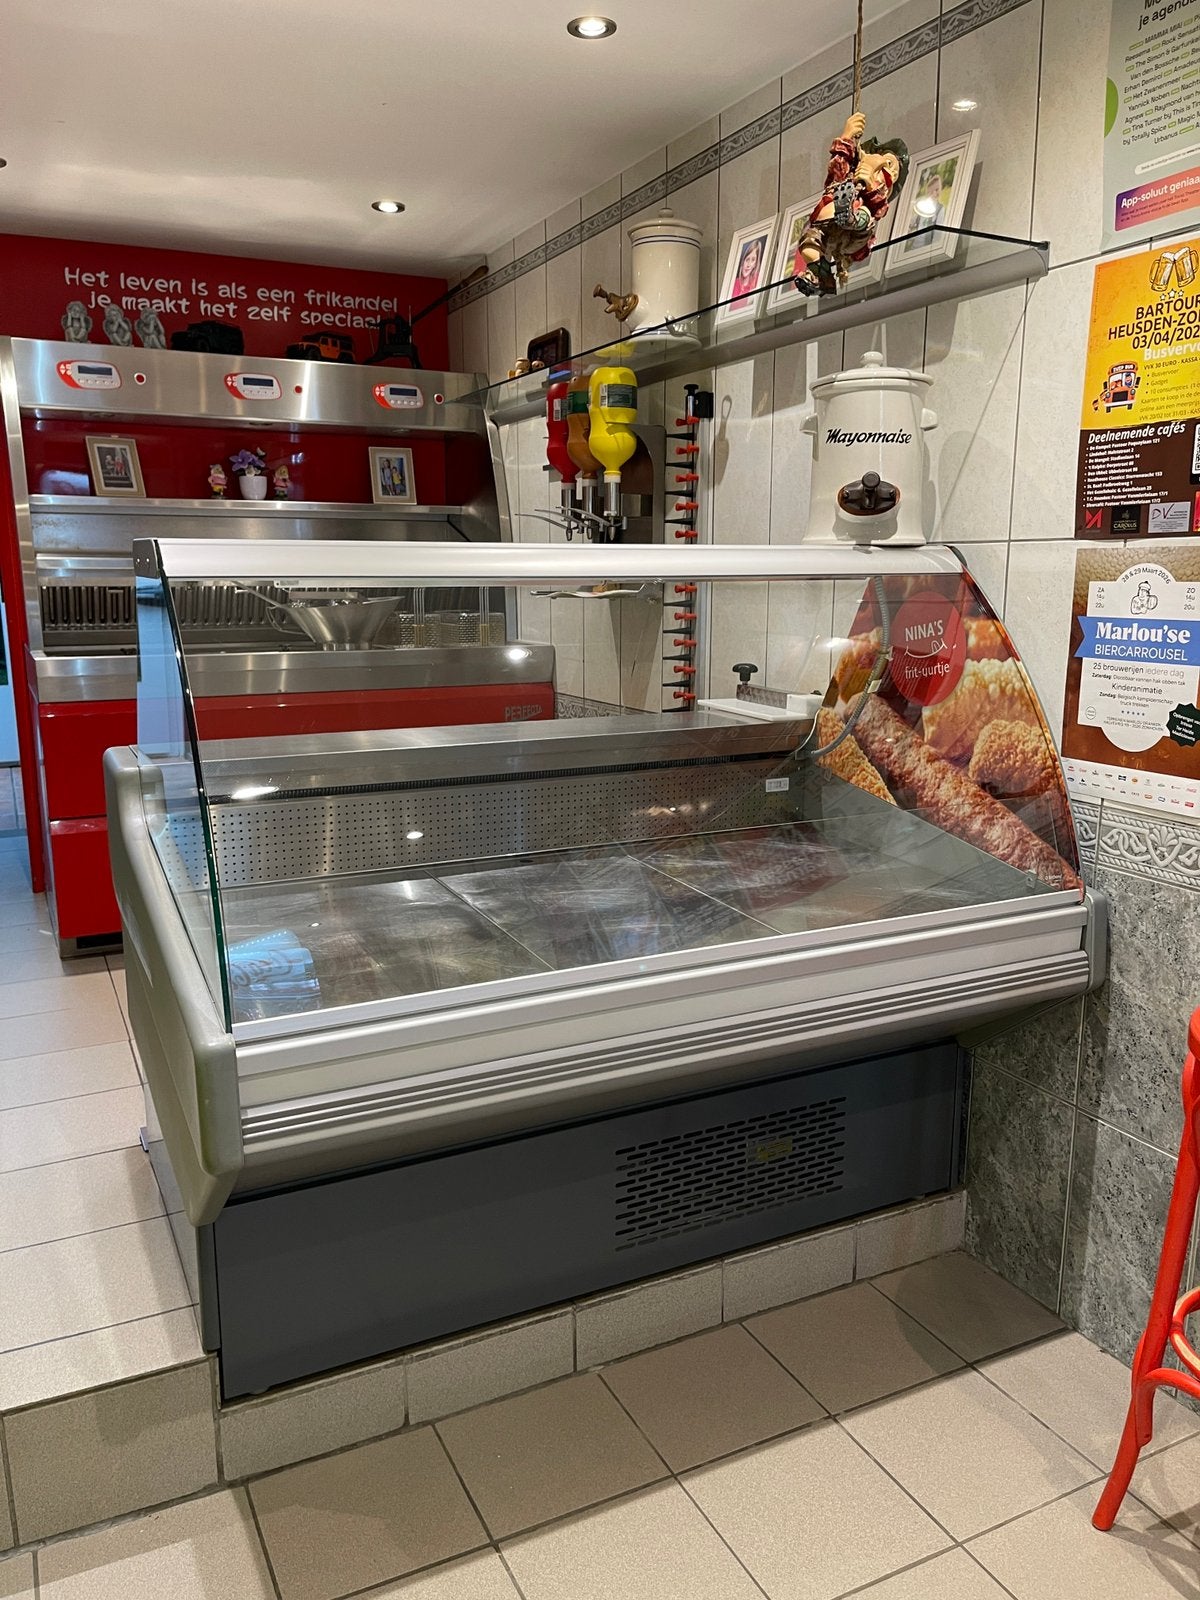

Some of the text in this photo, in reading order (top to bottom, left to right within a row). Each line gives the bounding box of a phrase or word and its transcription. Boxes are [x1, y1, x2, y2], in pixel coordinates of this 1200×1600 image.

[1137, 15, 1150, 31] je
[1162, 37, 1176, 47] Rock
[1135, 60, 1146, 68] The
[1147, 52, 1166, 63] Simon
[1155, 96, 1183, 112] Raymond
[1163, 112, 1172, 120] by
[1173, 107, 1185, 115] This
[1123, 138, 1131, 146] by
[1151, 125, 1167, 135] Spice
[1154, 131, 1178, 144] Urbanus
[1121, 184, 1168, 209] App-soluut
[65, 266, 109, 288] Het
[119, 272, 182, 293] leven
[218, 283, 248, 300] als
[257, 287, 296, 304] een
[303, 289, 398, 313] frikandel
[88, 291, 112, 309] je
[121, 296, 191, 315] maakt
[200, 299, 239, 319] het
[246, 305, 293, 322] zelf
[825, 427, 912, 447] Mayonnaise
[1087, 419, 1186, 445] Deelnemende cafés
[1142, 567, 1158, 575] Maart
[1157, 570, 1171, 584] 2026
[904, 619, 945, 642] NINA'S
[1094, 621, 1192, 645] Marlou'se
[1093, 643, 1188, 662] BIERCARROUSEL
[1091, 662, 1102, 671] 25
[1102, 664, 1144, 675] brouwerijen
[1169, 668, 1185, 680] dag
[1111, 683, 1163, 695] Kinderanimatie
